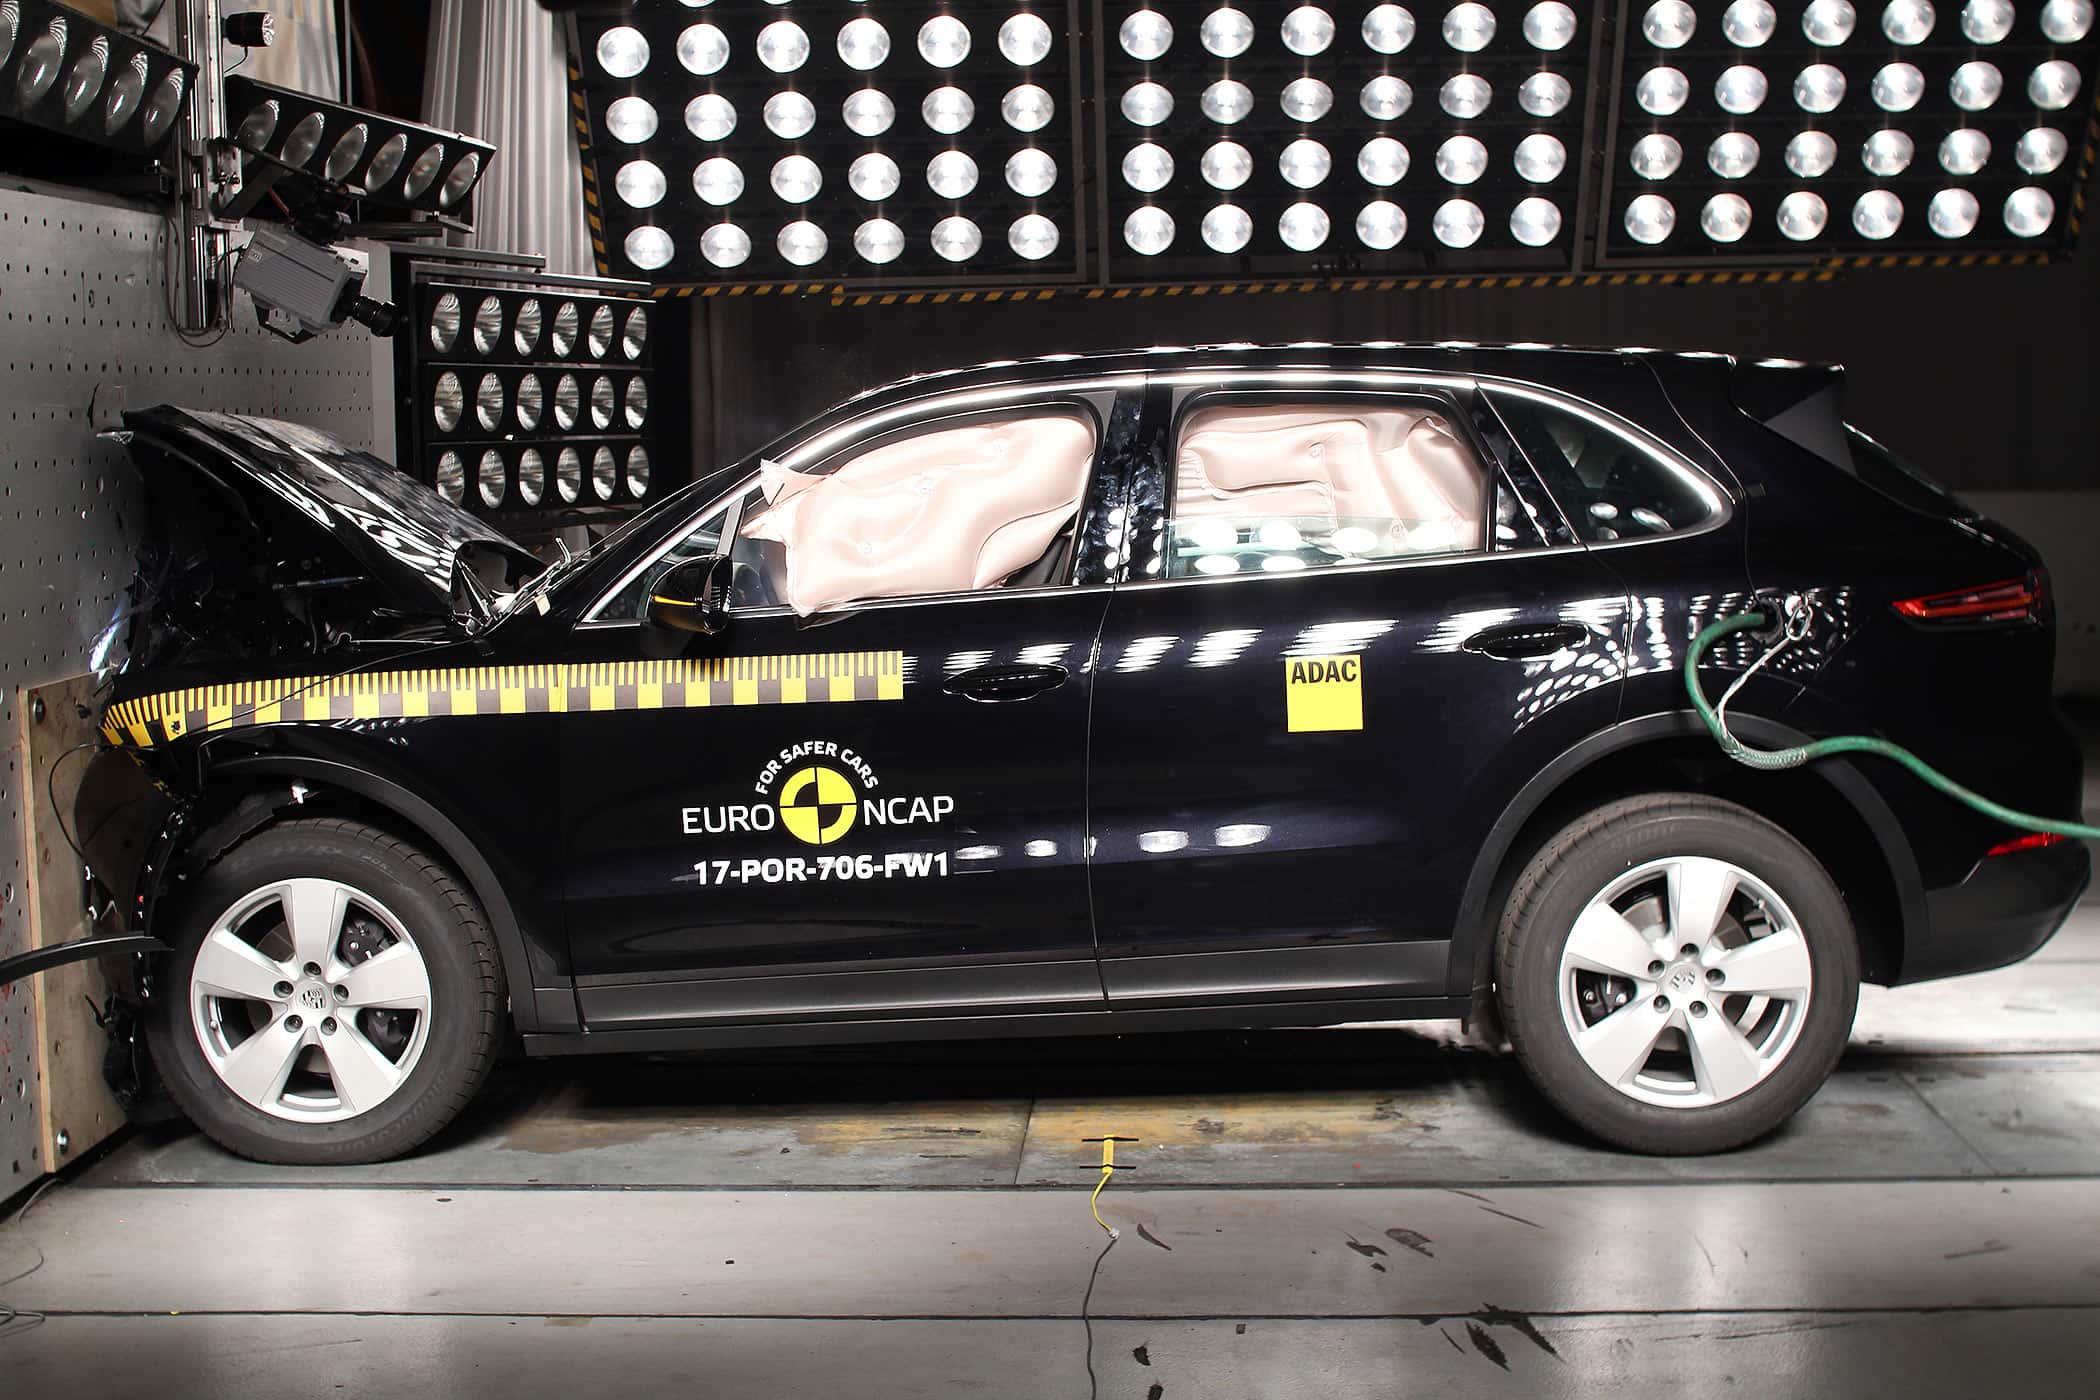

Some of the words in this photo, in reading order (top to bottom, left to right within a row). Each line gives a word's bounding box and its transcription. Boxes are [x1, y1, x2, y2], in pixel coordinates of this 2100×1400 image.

[1291, 659, 1357, 684] ADAC
[755, 759, 783, 795] FOR
[780, 740, 838, 765] SAFER
[840, 748, 879, 789] CARS
[682, 803, 775, 834] EURO
[863, 795, 954, 825] NCAP
[693, 852, 948, 885] 17-POR-706-FW1
